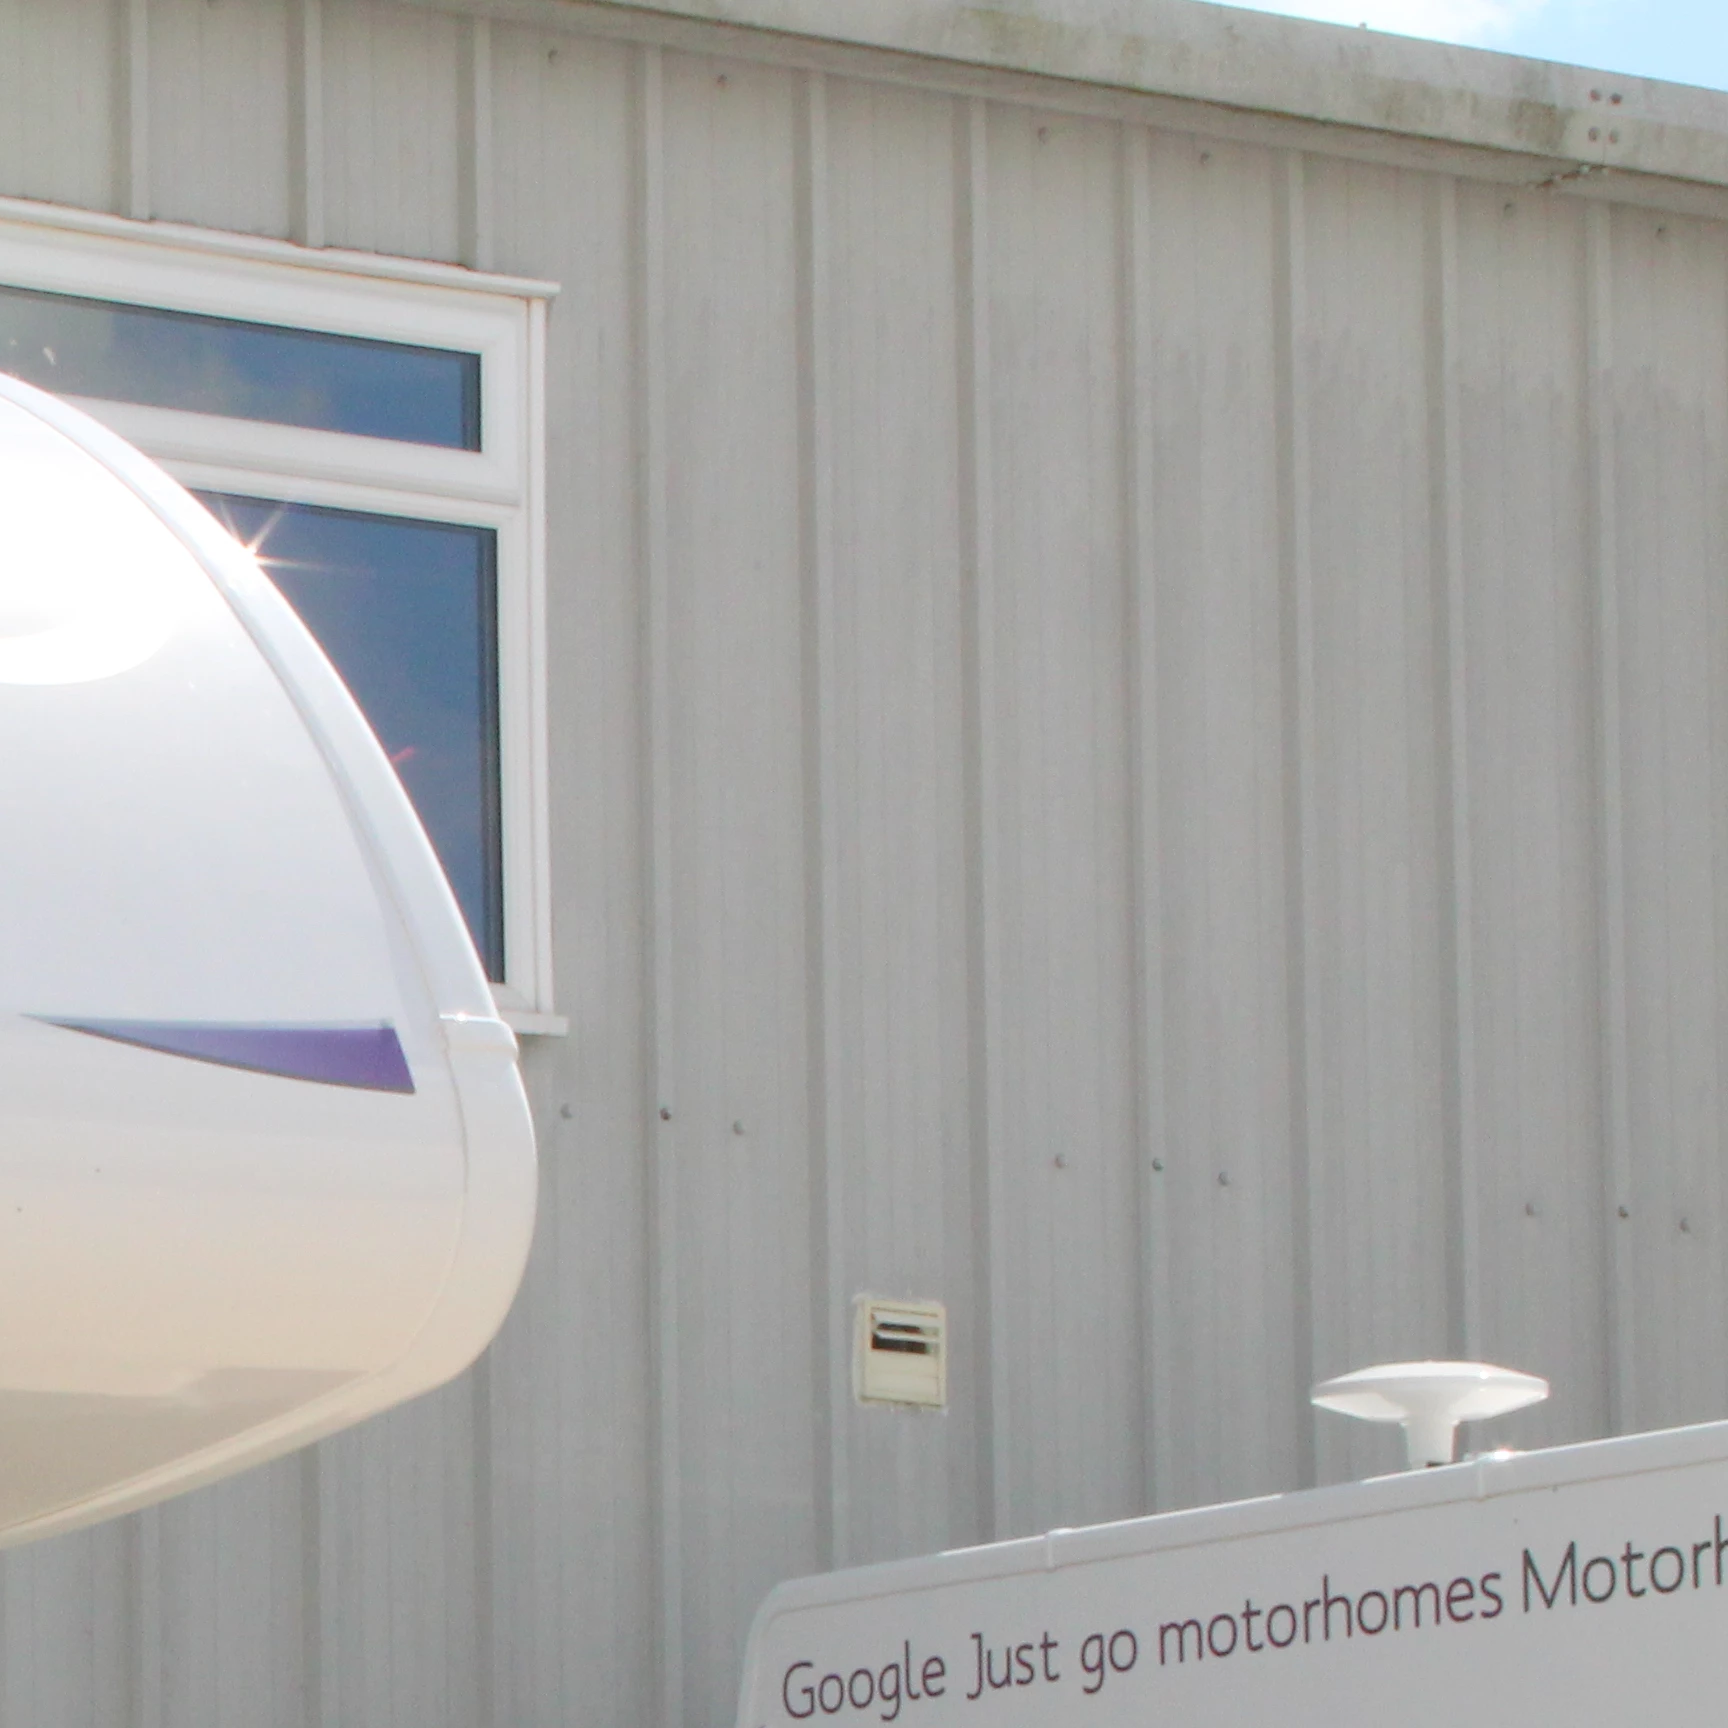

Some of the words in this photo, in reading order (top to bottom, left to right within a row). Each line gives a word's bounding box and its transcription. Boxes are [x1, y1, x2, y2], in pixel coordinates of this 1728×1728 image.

[782, 1639, 947, 1723] Google
[966, 1631, 1061, 1701] Just
[1079, 1628, 1139, 1696] go
[1158, 1573, 1505, 1666] motorhomes
